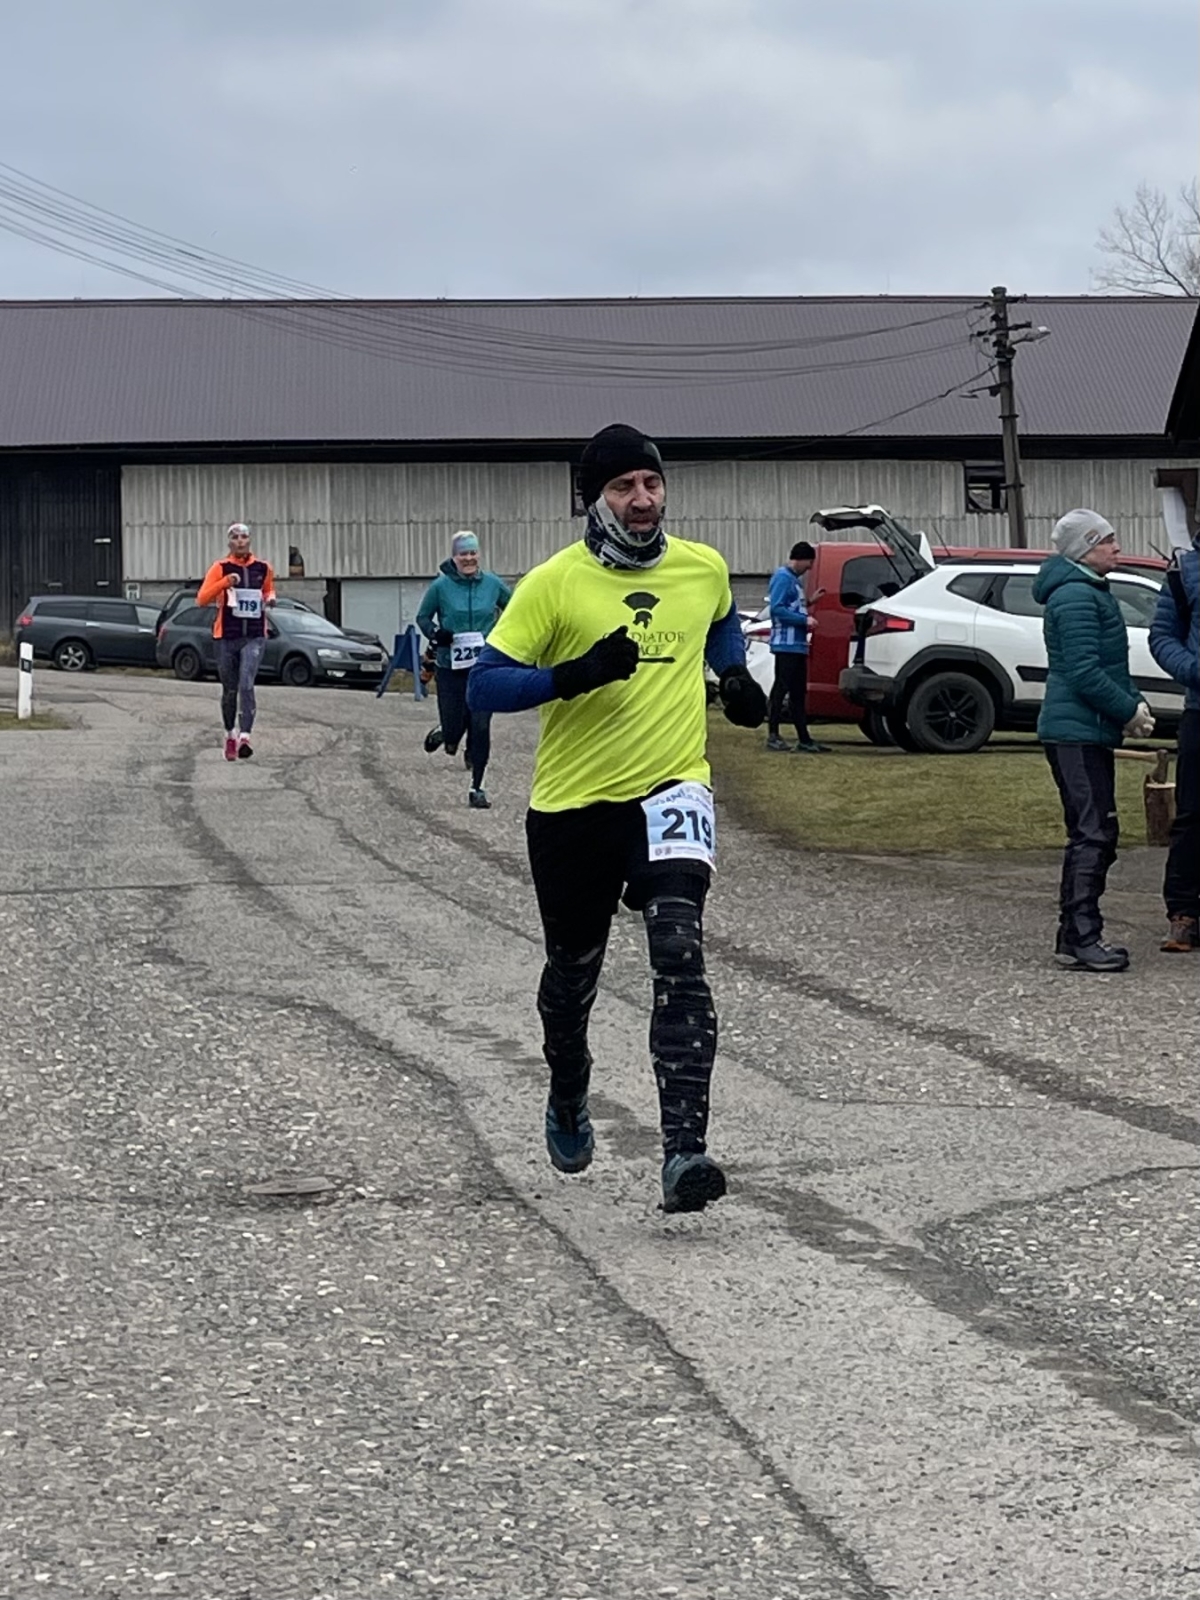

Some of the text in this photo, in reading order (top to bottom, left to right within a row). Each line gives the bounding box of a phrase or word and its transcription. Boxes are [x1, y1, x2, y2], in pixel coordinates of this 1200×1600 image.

[238, 599, 258, 612] 119
[602, 631, 685, 643] DIATOR
[639, 644, 665, 656] ACE
[661, 808, 712, 850] 219
